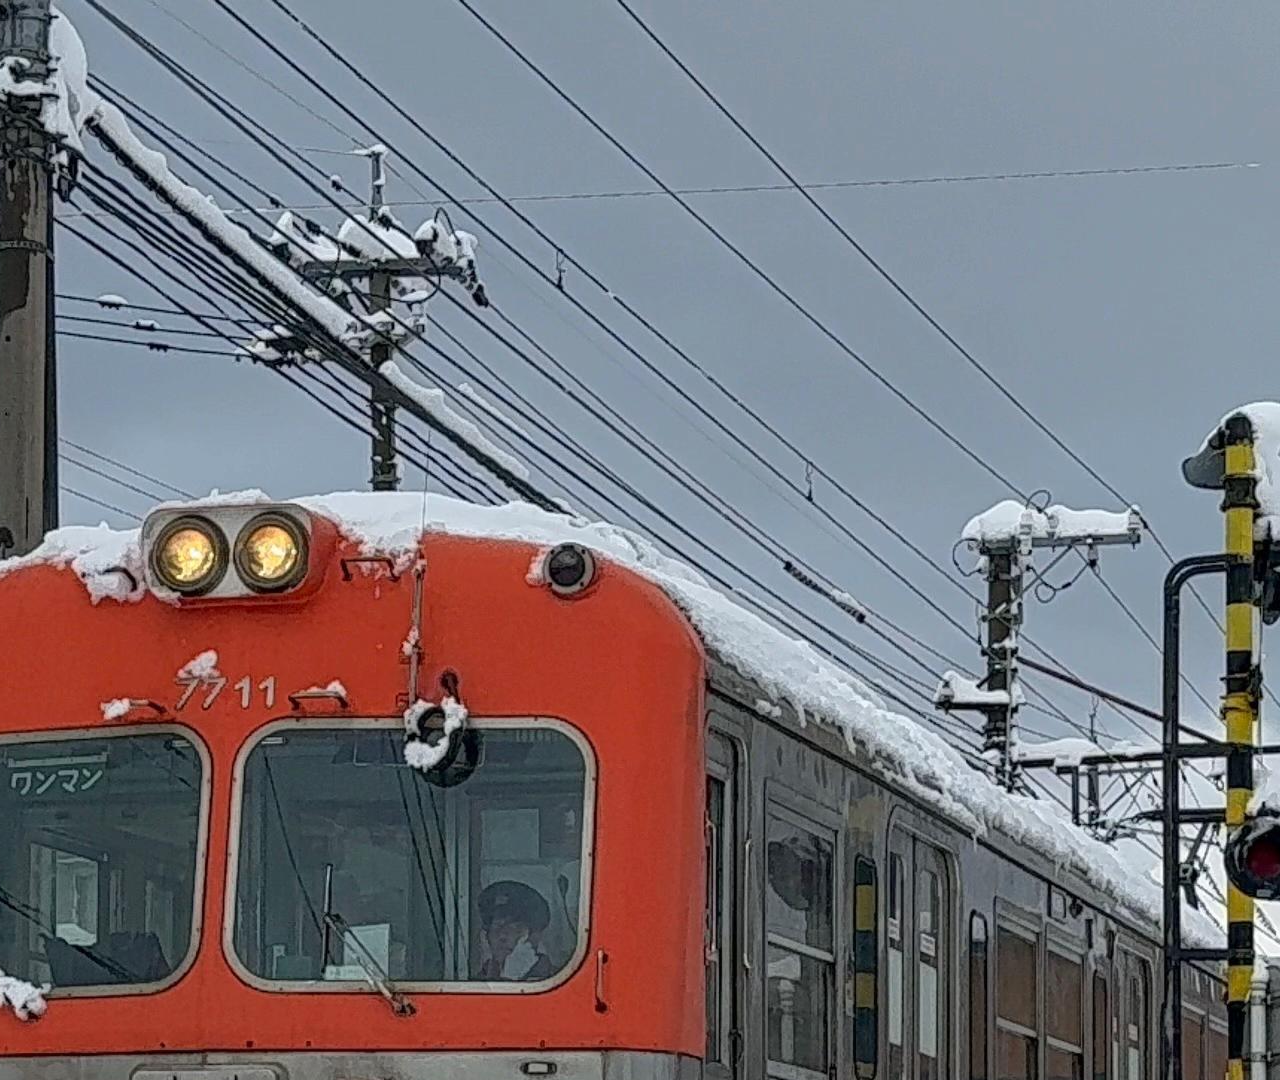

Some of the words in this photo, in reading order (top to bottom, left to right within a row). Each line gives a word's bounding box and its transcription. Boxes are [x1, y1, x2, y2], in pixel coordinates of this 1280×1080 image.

[175, 675, 276, 711] 7711
[10, 769, 103, 795] ワンマン
